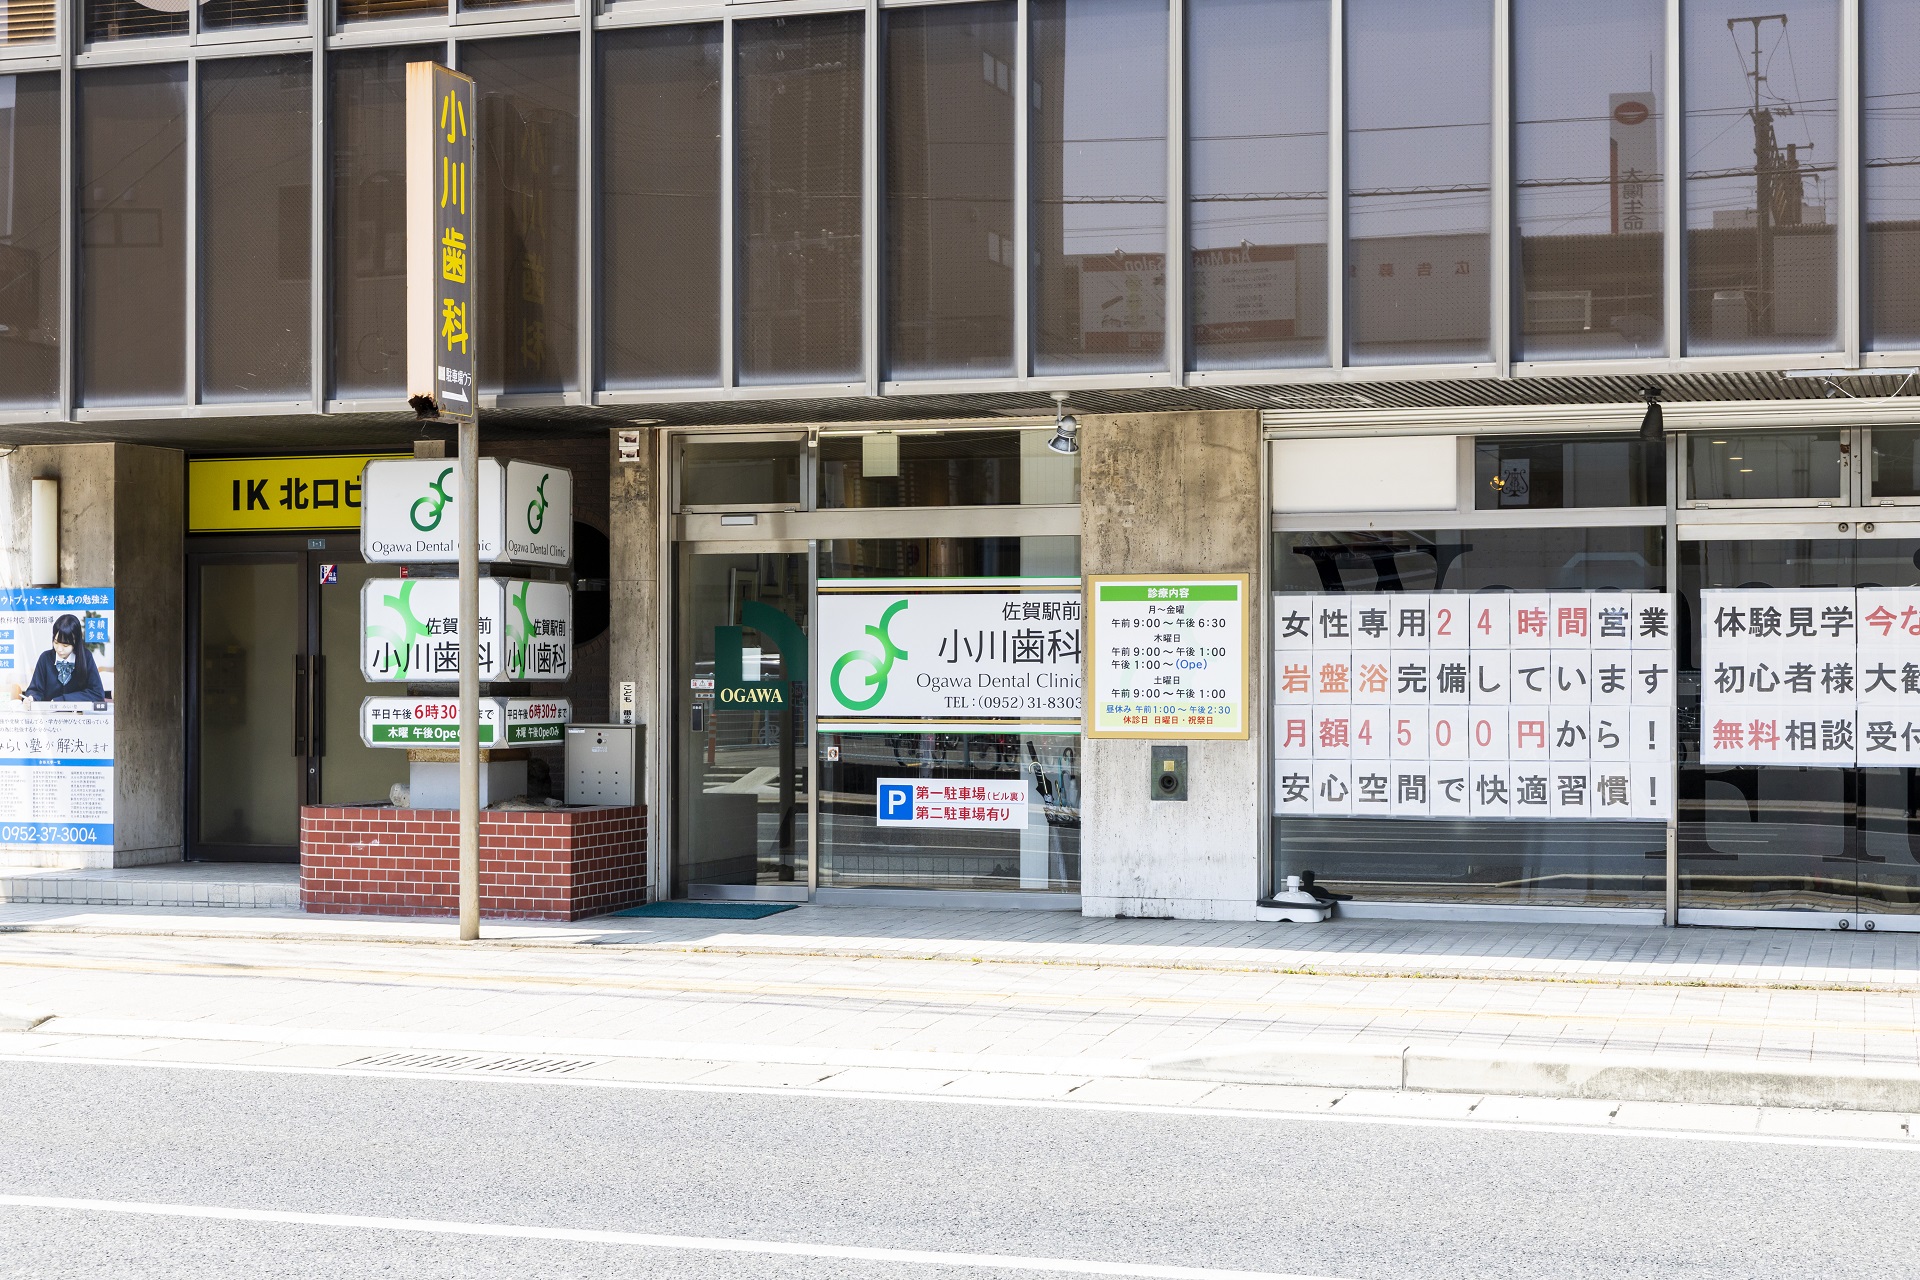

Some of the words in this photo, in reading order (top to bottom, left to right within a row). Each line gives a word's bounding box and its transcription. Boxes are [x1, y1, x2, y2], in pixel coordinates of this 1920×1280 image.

[441, 89, 469, 355] 小川歯科
[446, 367, 472, 387] 駐車場ウラ
[232, 479, 270, 511] IK
[372, 541, 412, 555] Ogawa
[416, 540, 454, 552] Dental
[508, 540, 529, 555] Ogawa
[529, 543, 549, 556] Dental
[550, 545, 566, 558] Clinic
[1147, 588, 1190, 599] 診療内容
[1001, 601, 1081, 621] 佐賀駅前
[88, 619, 105, 629] 実績
[426, 617, 492, 635] 佐賀前
[534, 619, 566, 636] 佐賀駅前
[88, 631, 105, 640] 多数
[1154, 634, 1181, 643] 木曜日
[938, 628, 1081, 664] 小川歯科
[508, 641, 567, 674] 小川歯科
[916, 673, 972, 692] Ogawa
[979, 672, 1030, 688] Dental
[1036, 672, 1081, 688] Clinic
[1154, 676, 1180, 685] 土曜日
[1282, 663, 1669, 694] 岩盤浴完備しています
[720, 688, 783, 703] OGAWA
[1123, 715, 1148, 725] 休診日
[1282, 772, 1656, 806] 安心空間で快適習慣!
[888, 790, 907, 815] P
[916, 806, 1010, 821] 第二駐車場有り
[2, 826, 97, 842] 0952-37-3004
